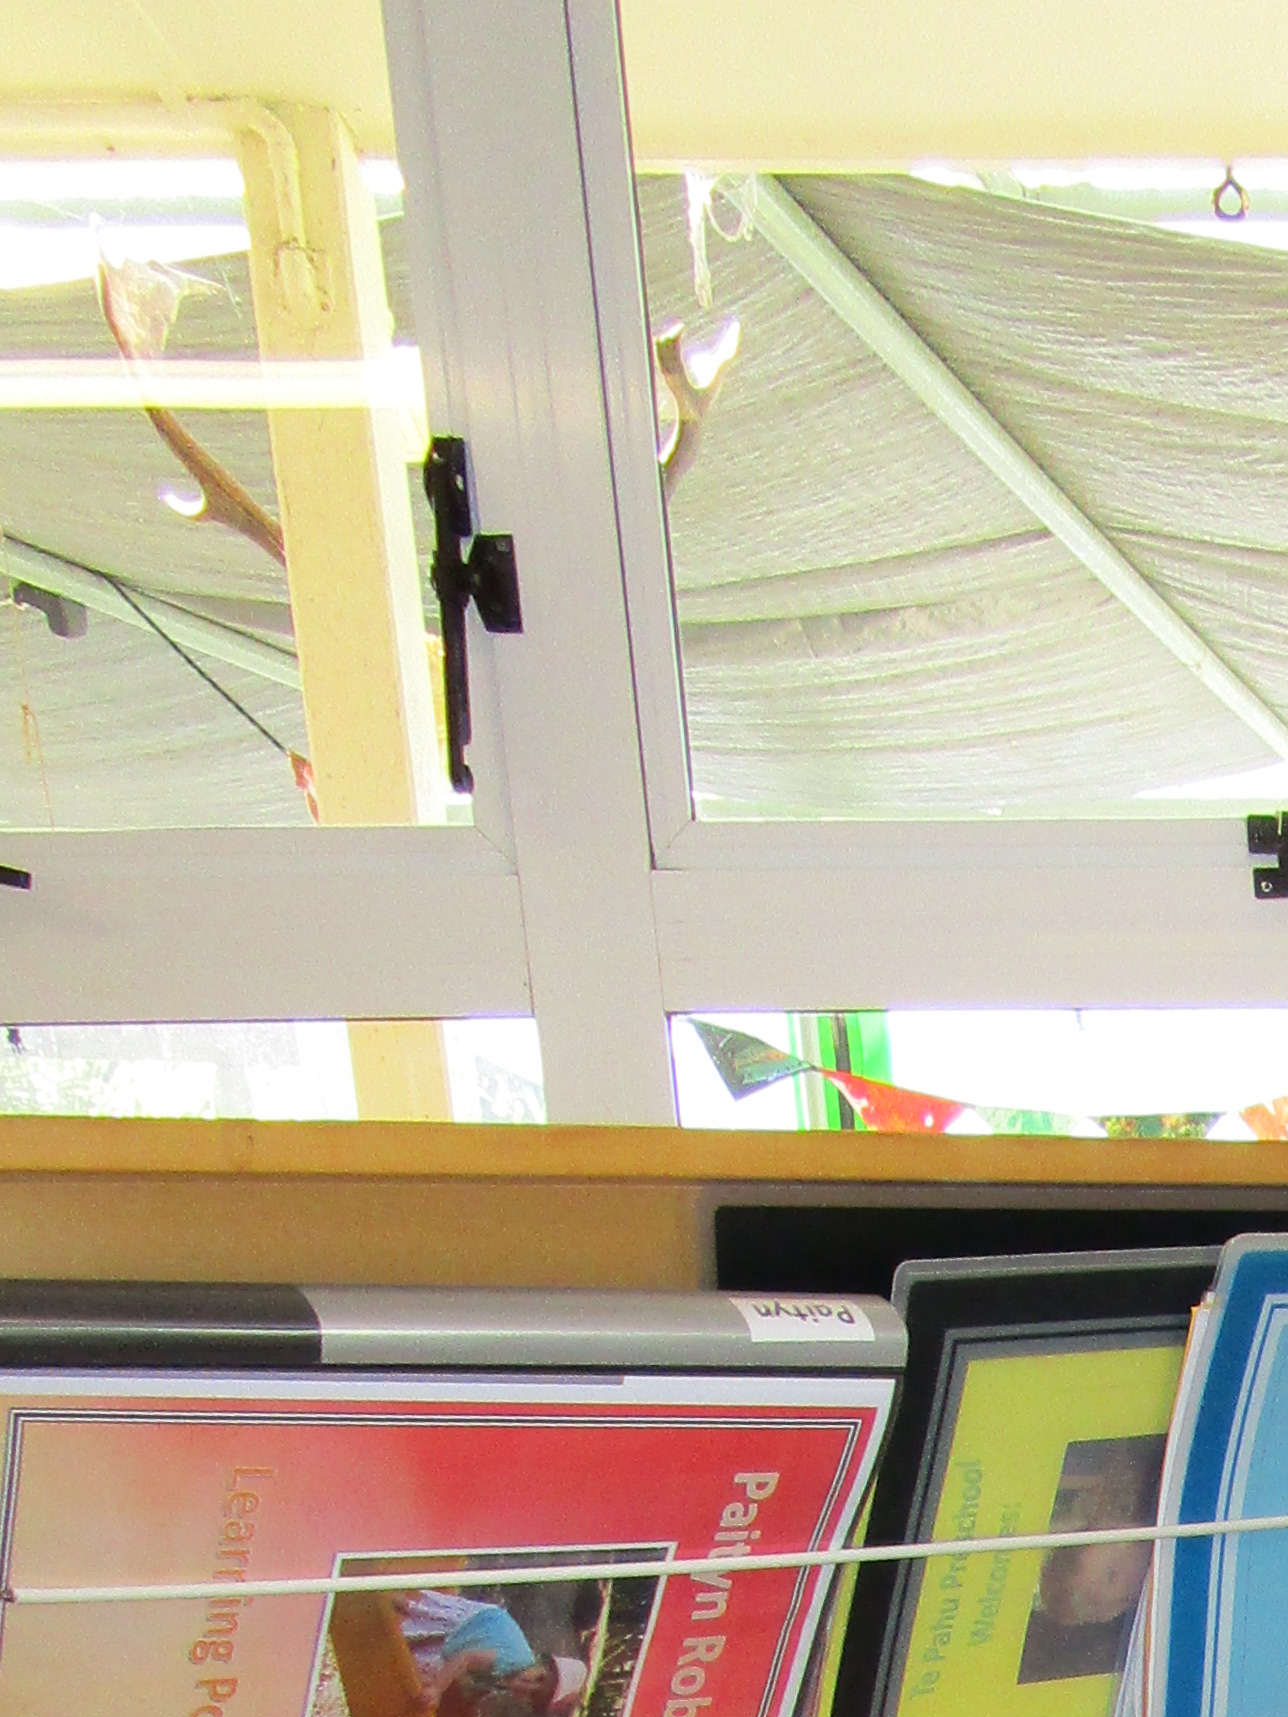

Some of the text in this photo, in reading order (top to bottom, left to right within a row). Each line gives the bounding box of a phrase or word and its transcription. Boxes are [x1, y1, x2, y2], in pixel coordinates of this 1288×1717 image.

[750, 1299, 856, 1327] Paityn
[187, 1464, 275, 1665] Learning
[688, 1470, 780, 1622] Paityn
[922, 1597, 960, 1663] Pahu
[909, 1670, 940, 1700] Te
